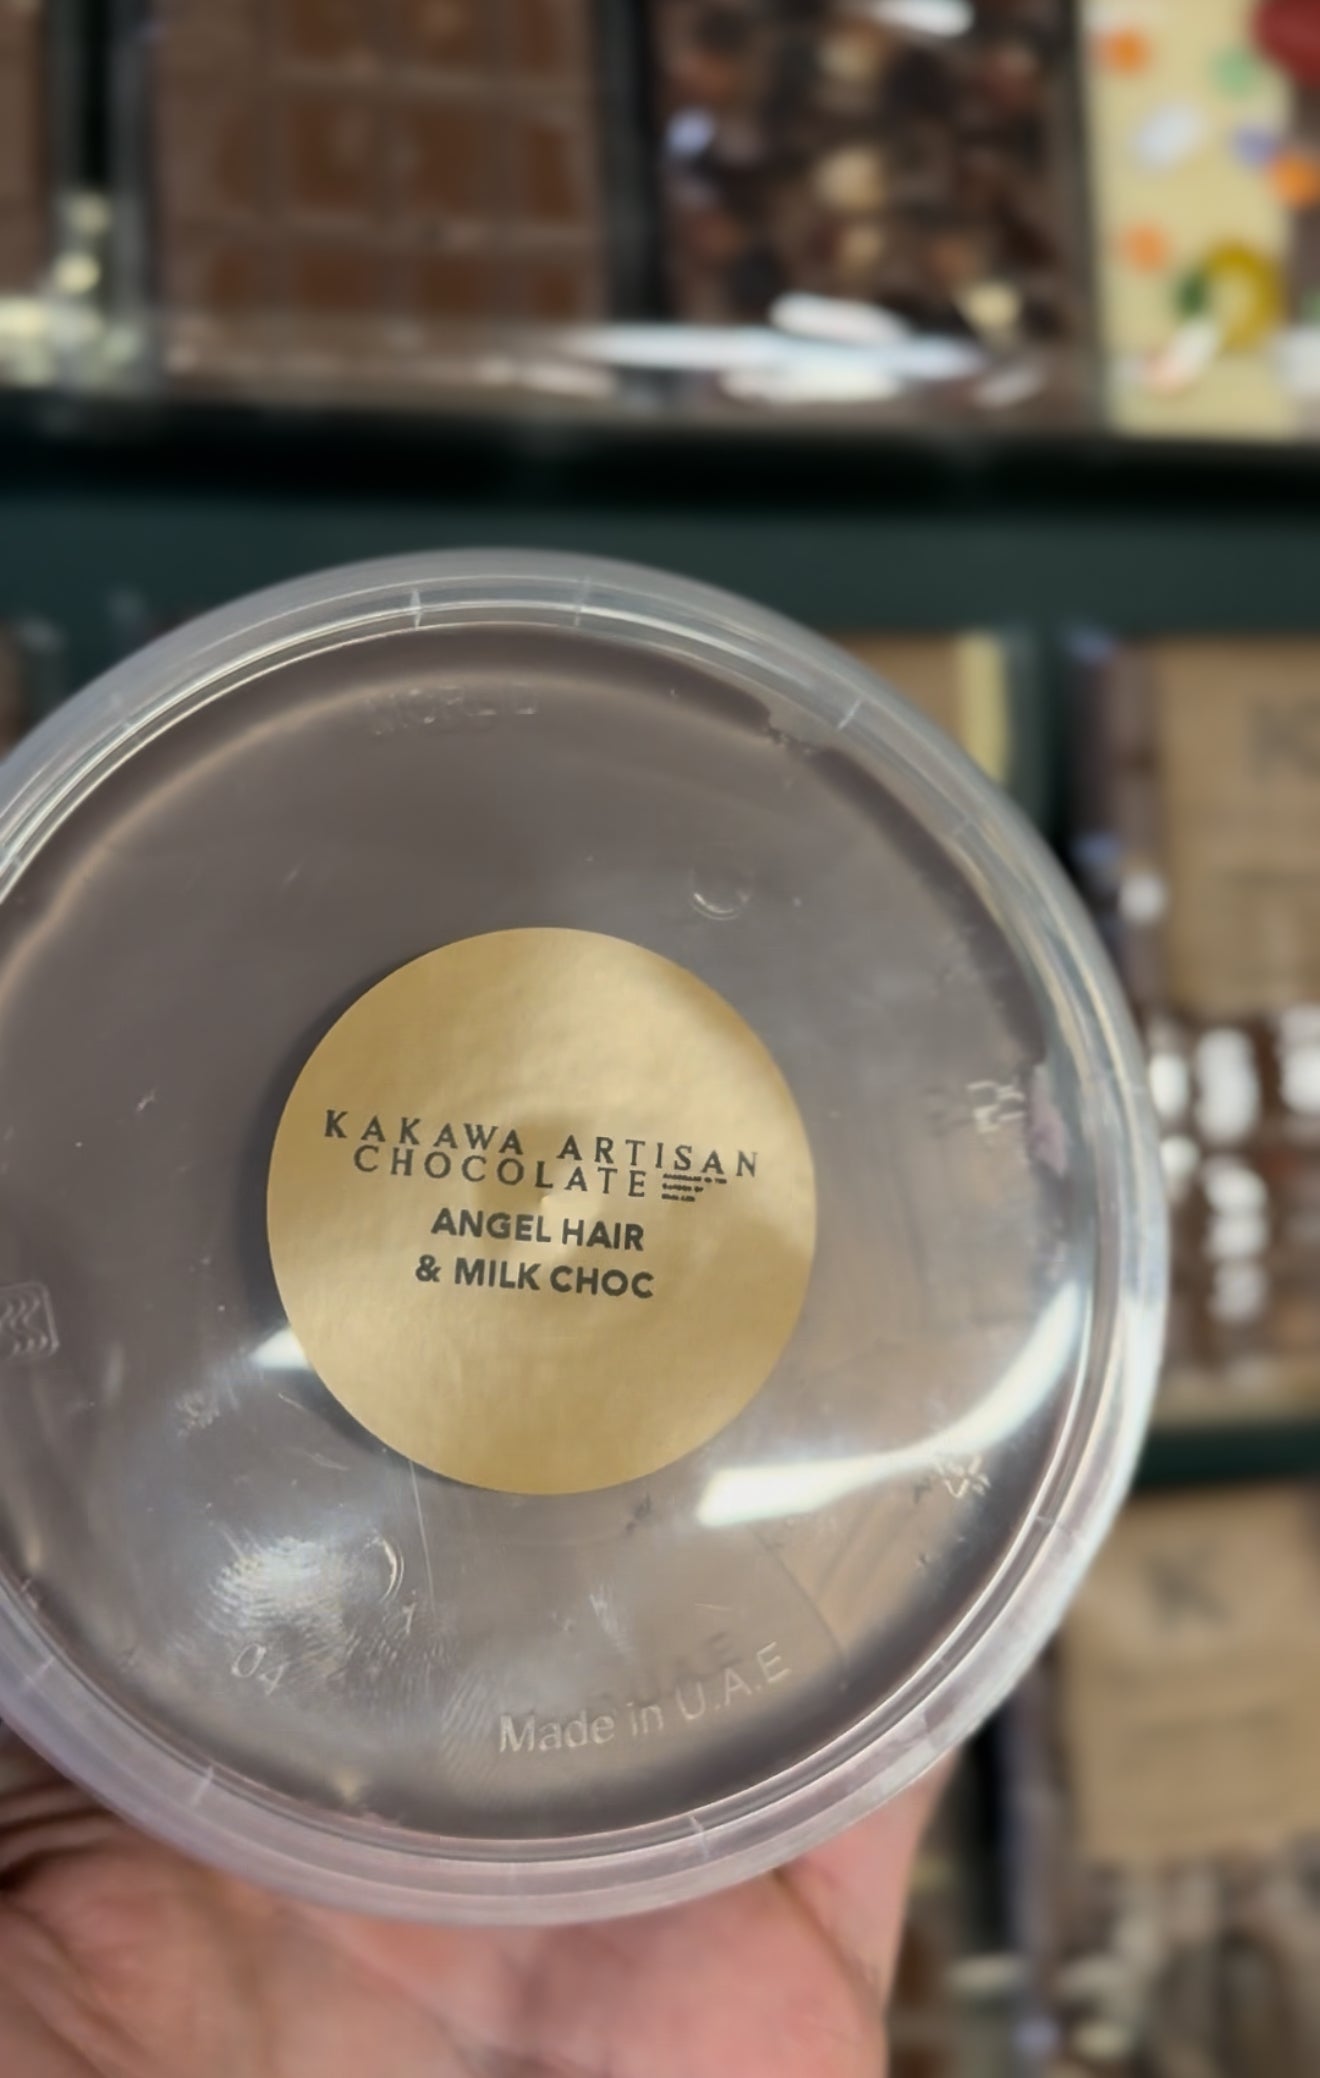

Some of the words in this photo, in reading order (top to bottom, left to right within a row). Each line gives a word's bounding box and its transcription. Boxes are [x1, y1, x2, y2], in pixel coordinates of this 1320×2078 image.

[324, 1109, 524, 1156] KAKAWA
[556, 1134, 758, 1178] ARTISAN
[353, 1144, 647, 1198] CHOCOLATE
[431, 1207, 552, 1243] ANGEL
[561, 1218, 645, 1252] HAIR
[415, 1254, 442, 1283] &
[454, 1257, 542, 1291] MILK
[550, 1265, 655, 1299] CHOC
[500, 1710, 616, 1752] Made
[626, 1701, 665, 1736] in
[674, 1641, 791, 1722] U.A.E
